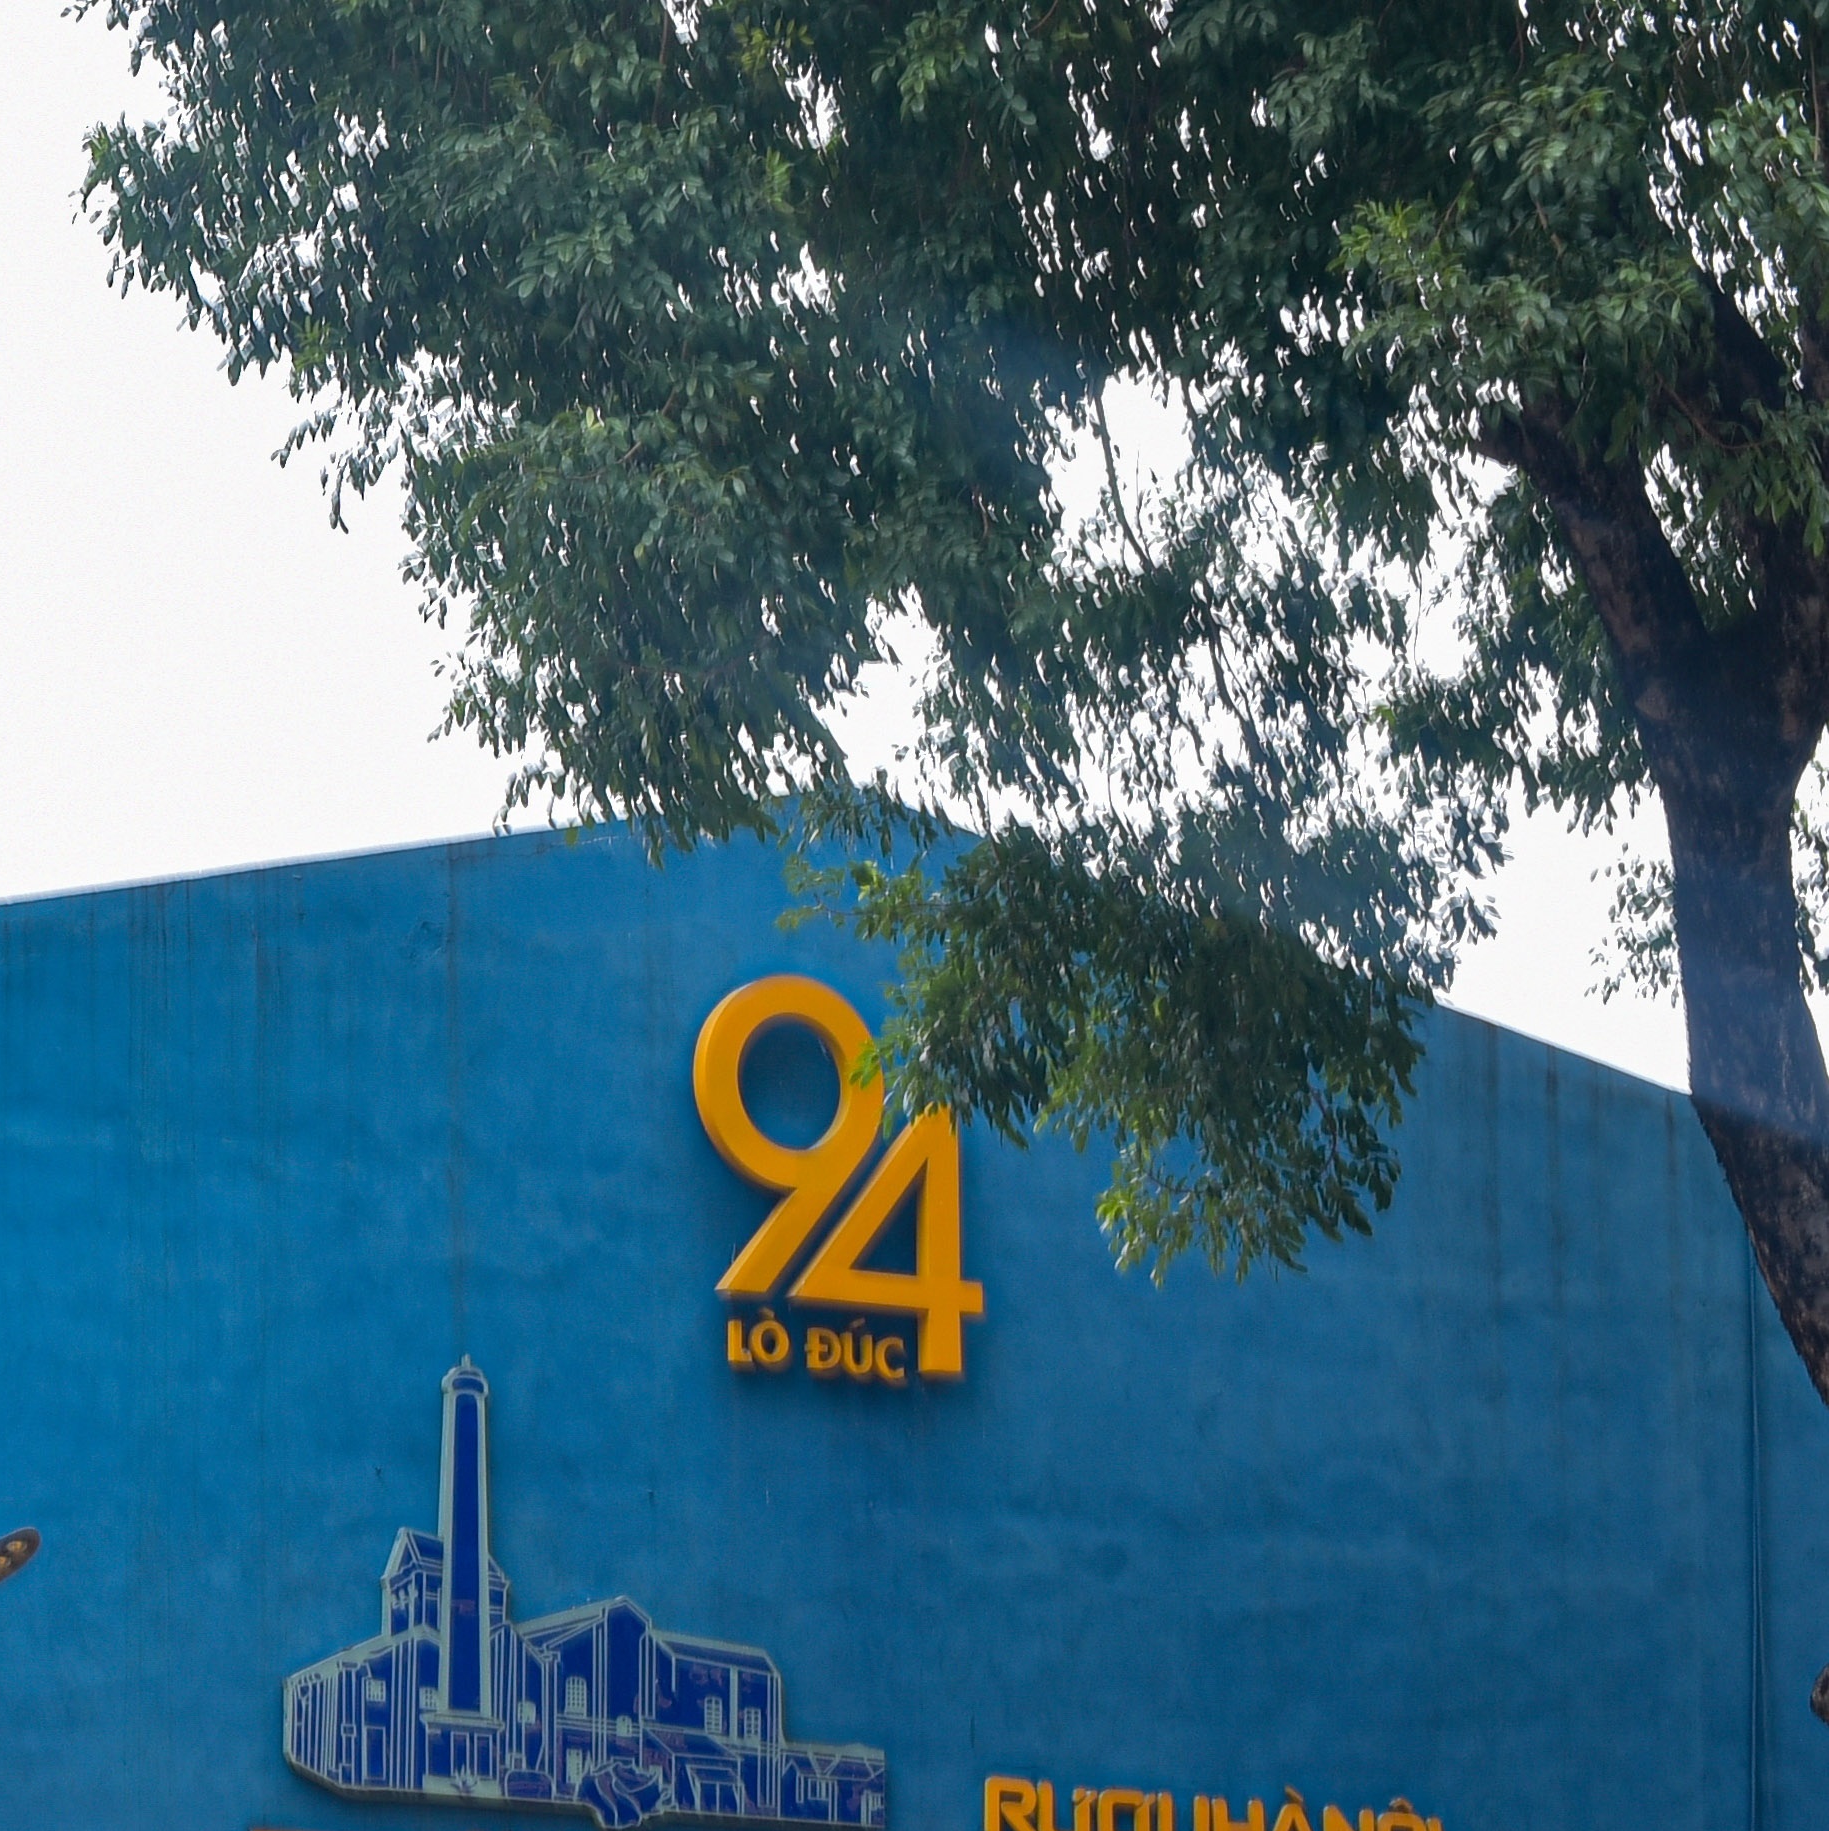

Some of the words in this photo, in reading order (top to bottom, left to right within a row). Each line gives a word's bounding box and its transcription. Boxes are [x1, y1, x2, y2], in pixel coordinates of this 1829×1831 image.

[694, 974, 983, 1373] 94
[727, 1307, 791, 1368] LÒ
[805, 1317, 906, 1380] ĐÚC
